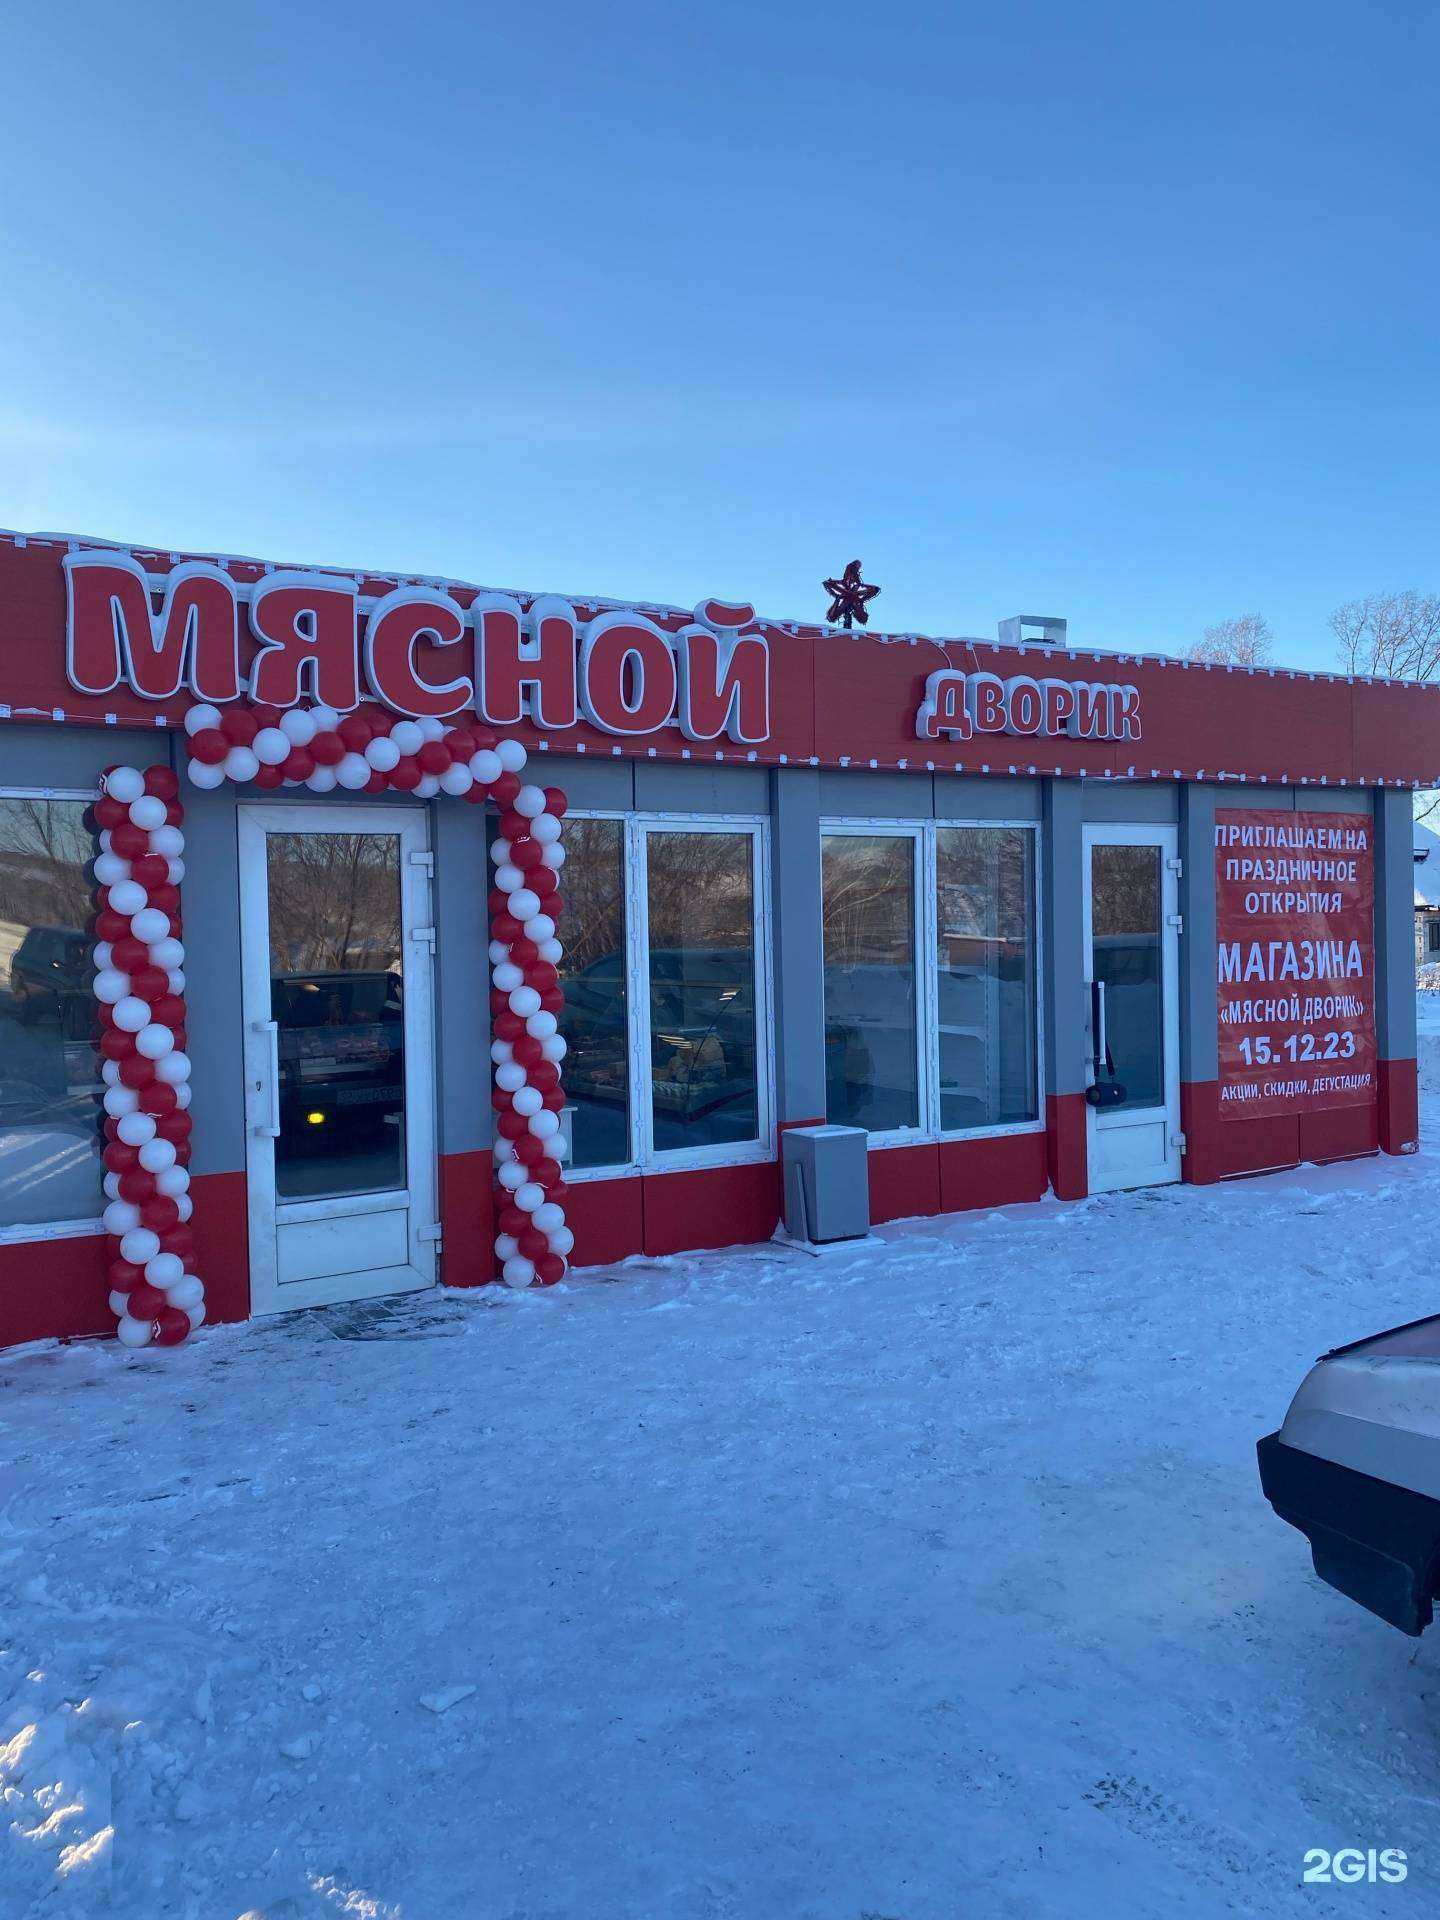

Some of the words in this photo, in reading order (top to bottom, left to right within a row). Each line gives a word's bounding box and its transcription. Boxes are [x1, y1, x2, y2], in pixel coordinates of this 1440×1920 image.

[63, 552, 769, 744] МЯСНОЙ
[917, 669, 1141, 740] ДВОРИК
[1215, 824, 1342, 849] ПРИГЛАШАЕМ
[1346, 829, 1367, 849] НА
[1226, 859, 1357, 885] ПРАЗДНИЧНОЕ
[1245, 892, 1342, 914] ОТКРЫТИЯ
[1218, 940, 1363, 983] МАГАЗИНА
[1221, 993, 1299, 1024] «МЯСНОЙ
[1303, 995, 1363, 1024] ДВОРИК»
[1239, 1031, 1356, 1065] 15.12.23
[1222, 1085, 1261, 1101] АКЦИИ,
[1264, 1078, 1310, 1098] СКИДКИ,
[1312, 1073, 1371, 1095] ДЕГУСТАЦИЯ
